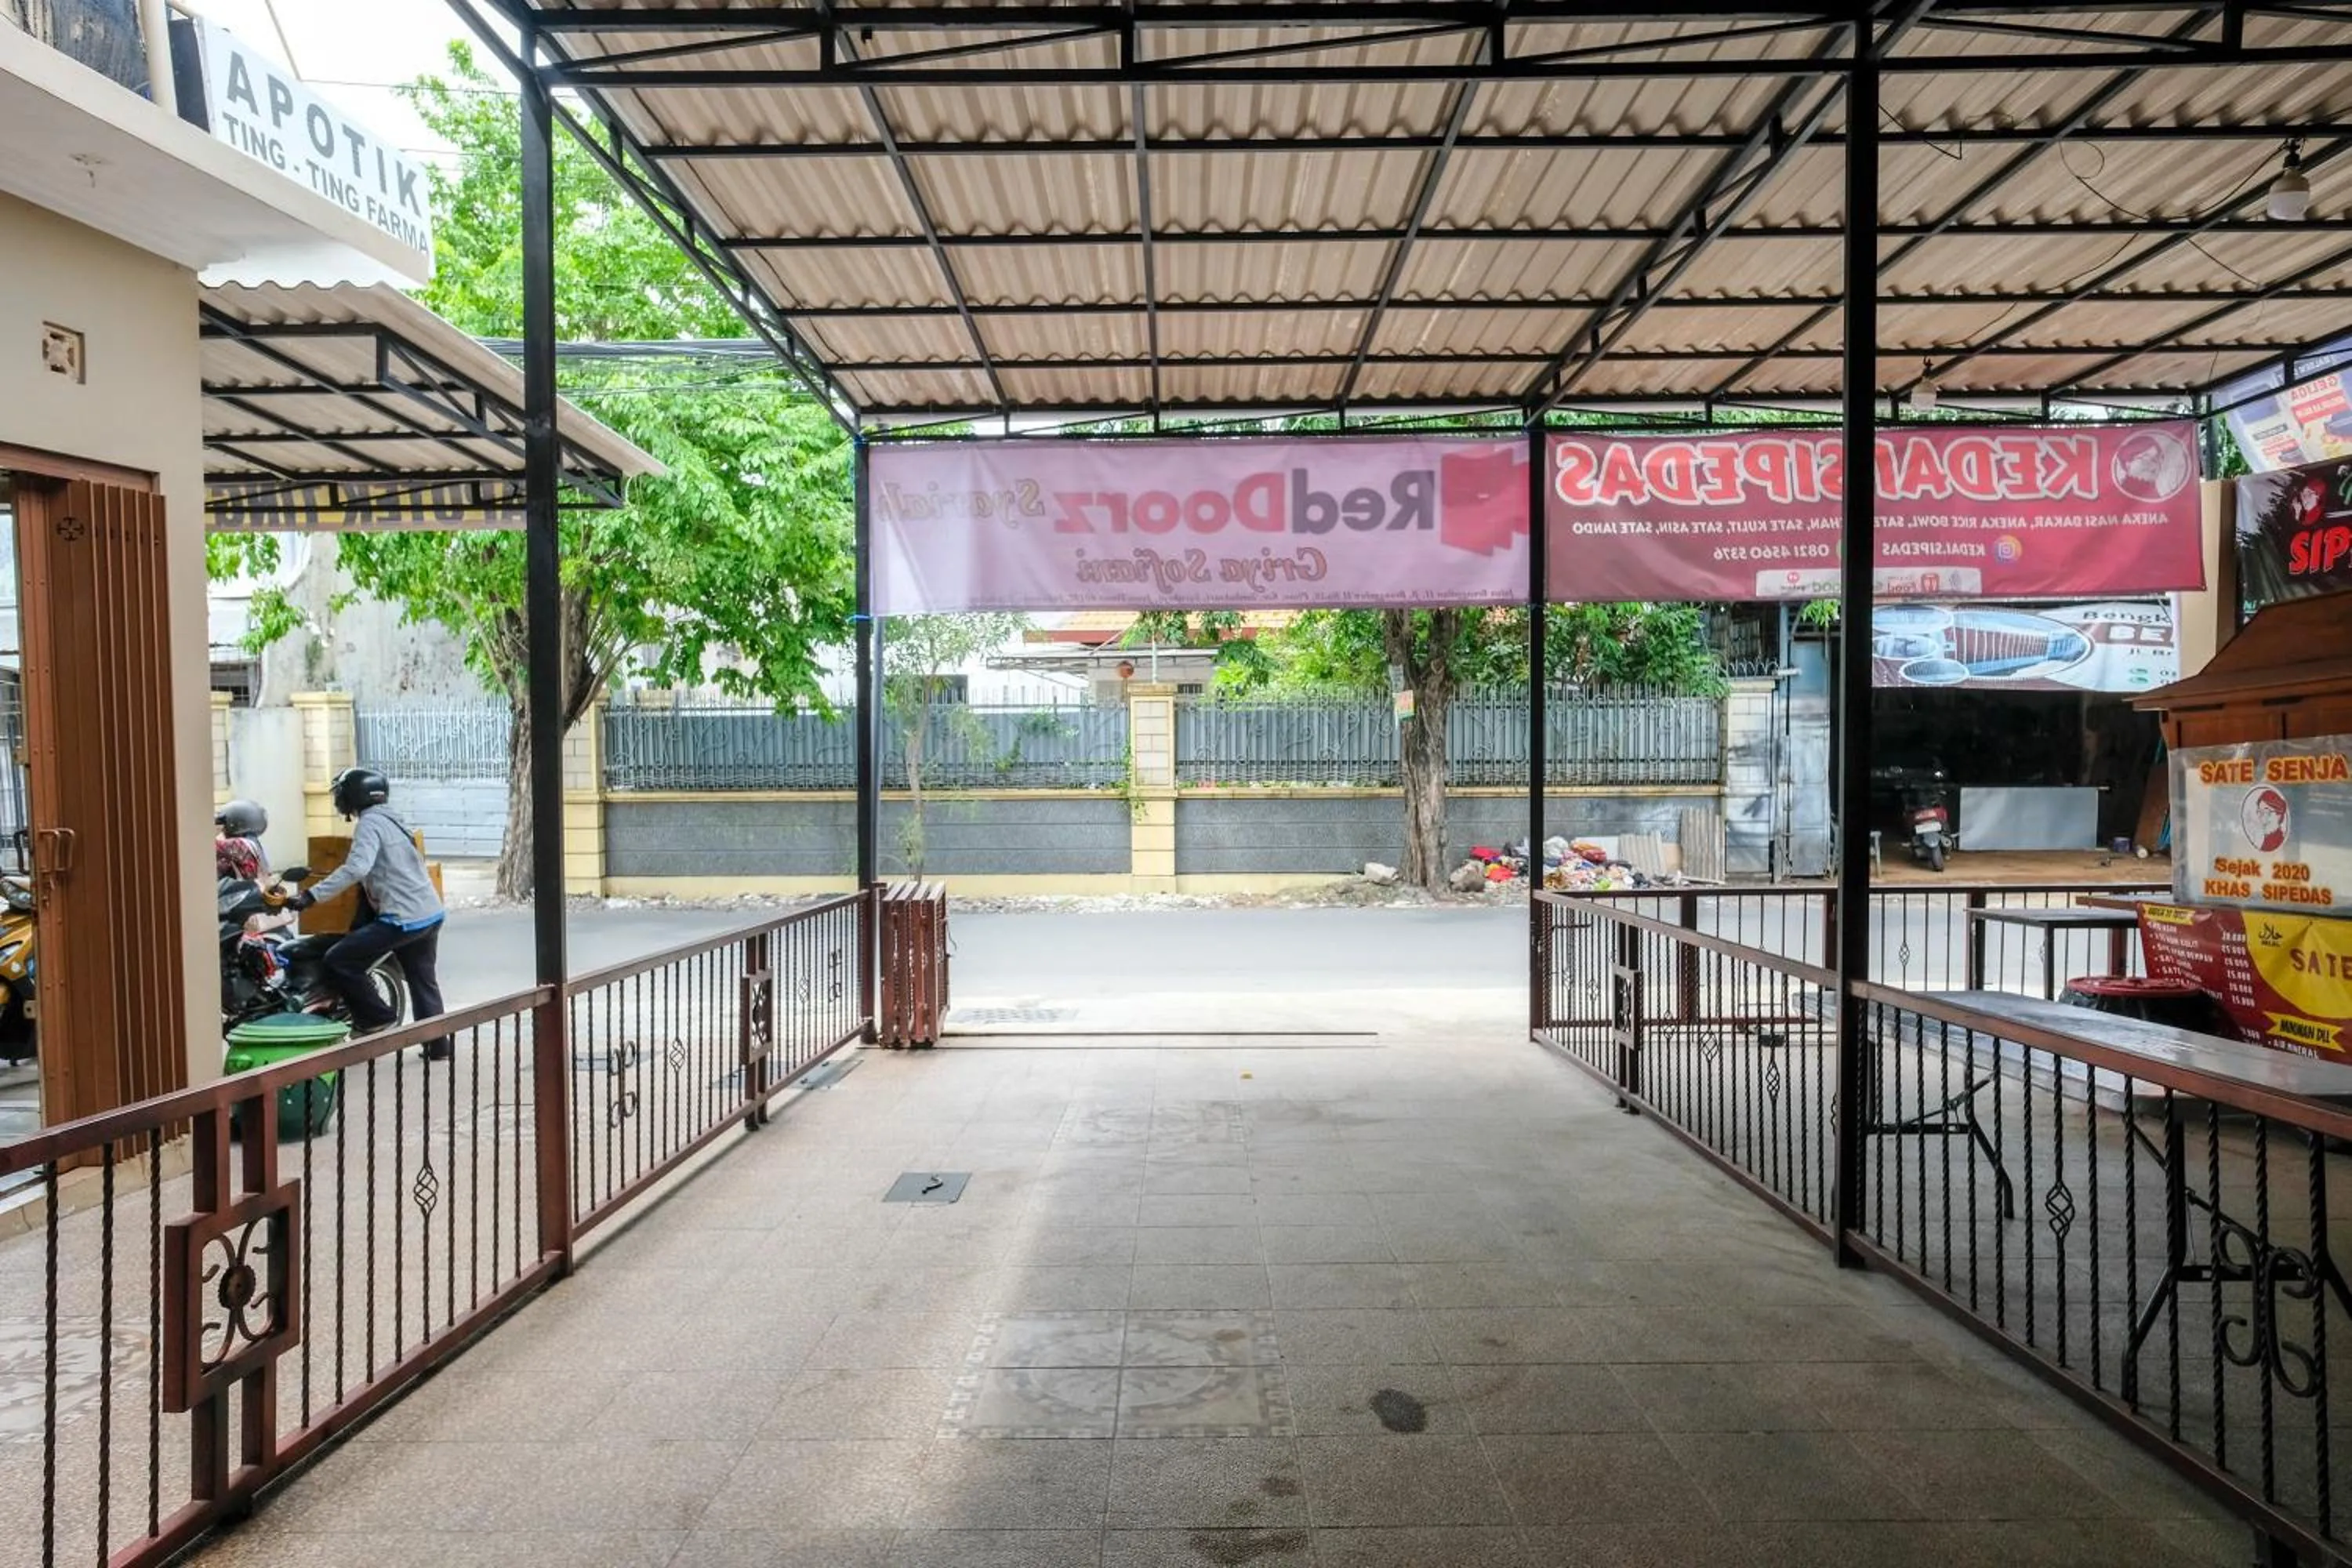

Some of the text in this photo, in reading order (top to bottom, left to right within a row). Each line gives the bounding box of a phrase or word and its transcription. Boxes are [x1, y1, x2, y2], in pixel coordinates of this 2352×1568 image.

[227, 50, 422, 218] APOTIK
[222, 111, 286, 170] TING
[306, 158, 361, 213] TING
[366, 196, 429, 254] FARMA
[2288, 525, 2352, 575] SIP
[2199, 753, 2350, 785] SATE SENJA
[2214, 856, 2310, 882] Sejak 2020
[2204, 878, 2332, 905] KHAS SIPEDAS
[2289, 947, 2352, 981] SATE
